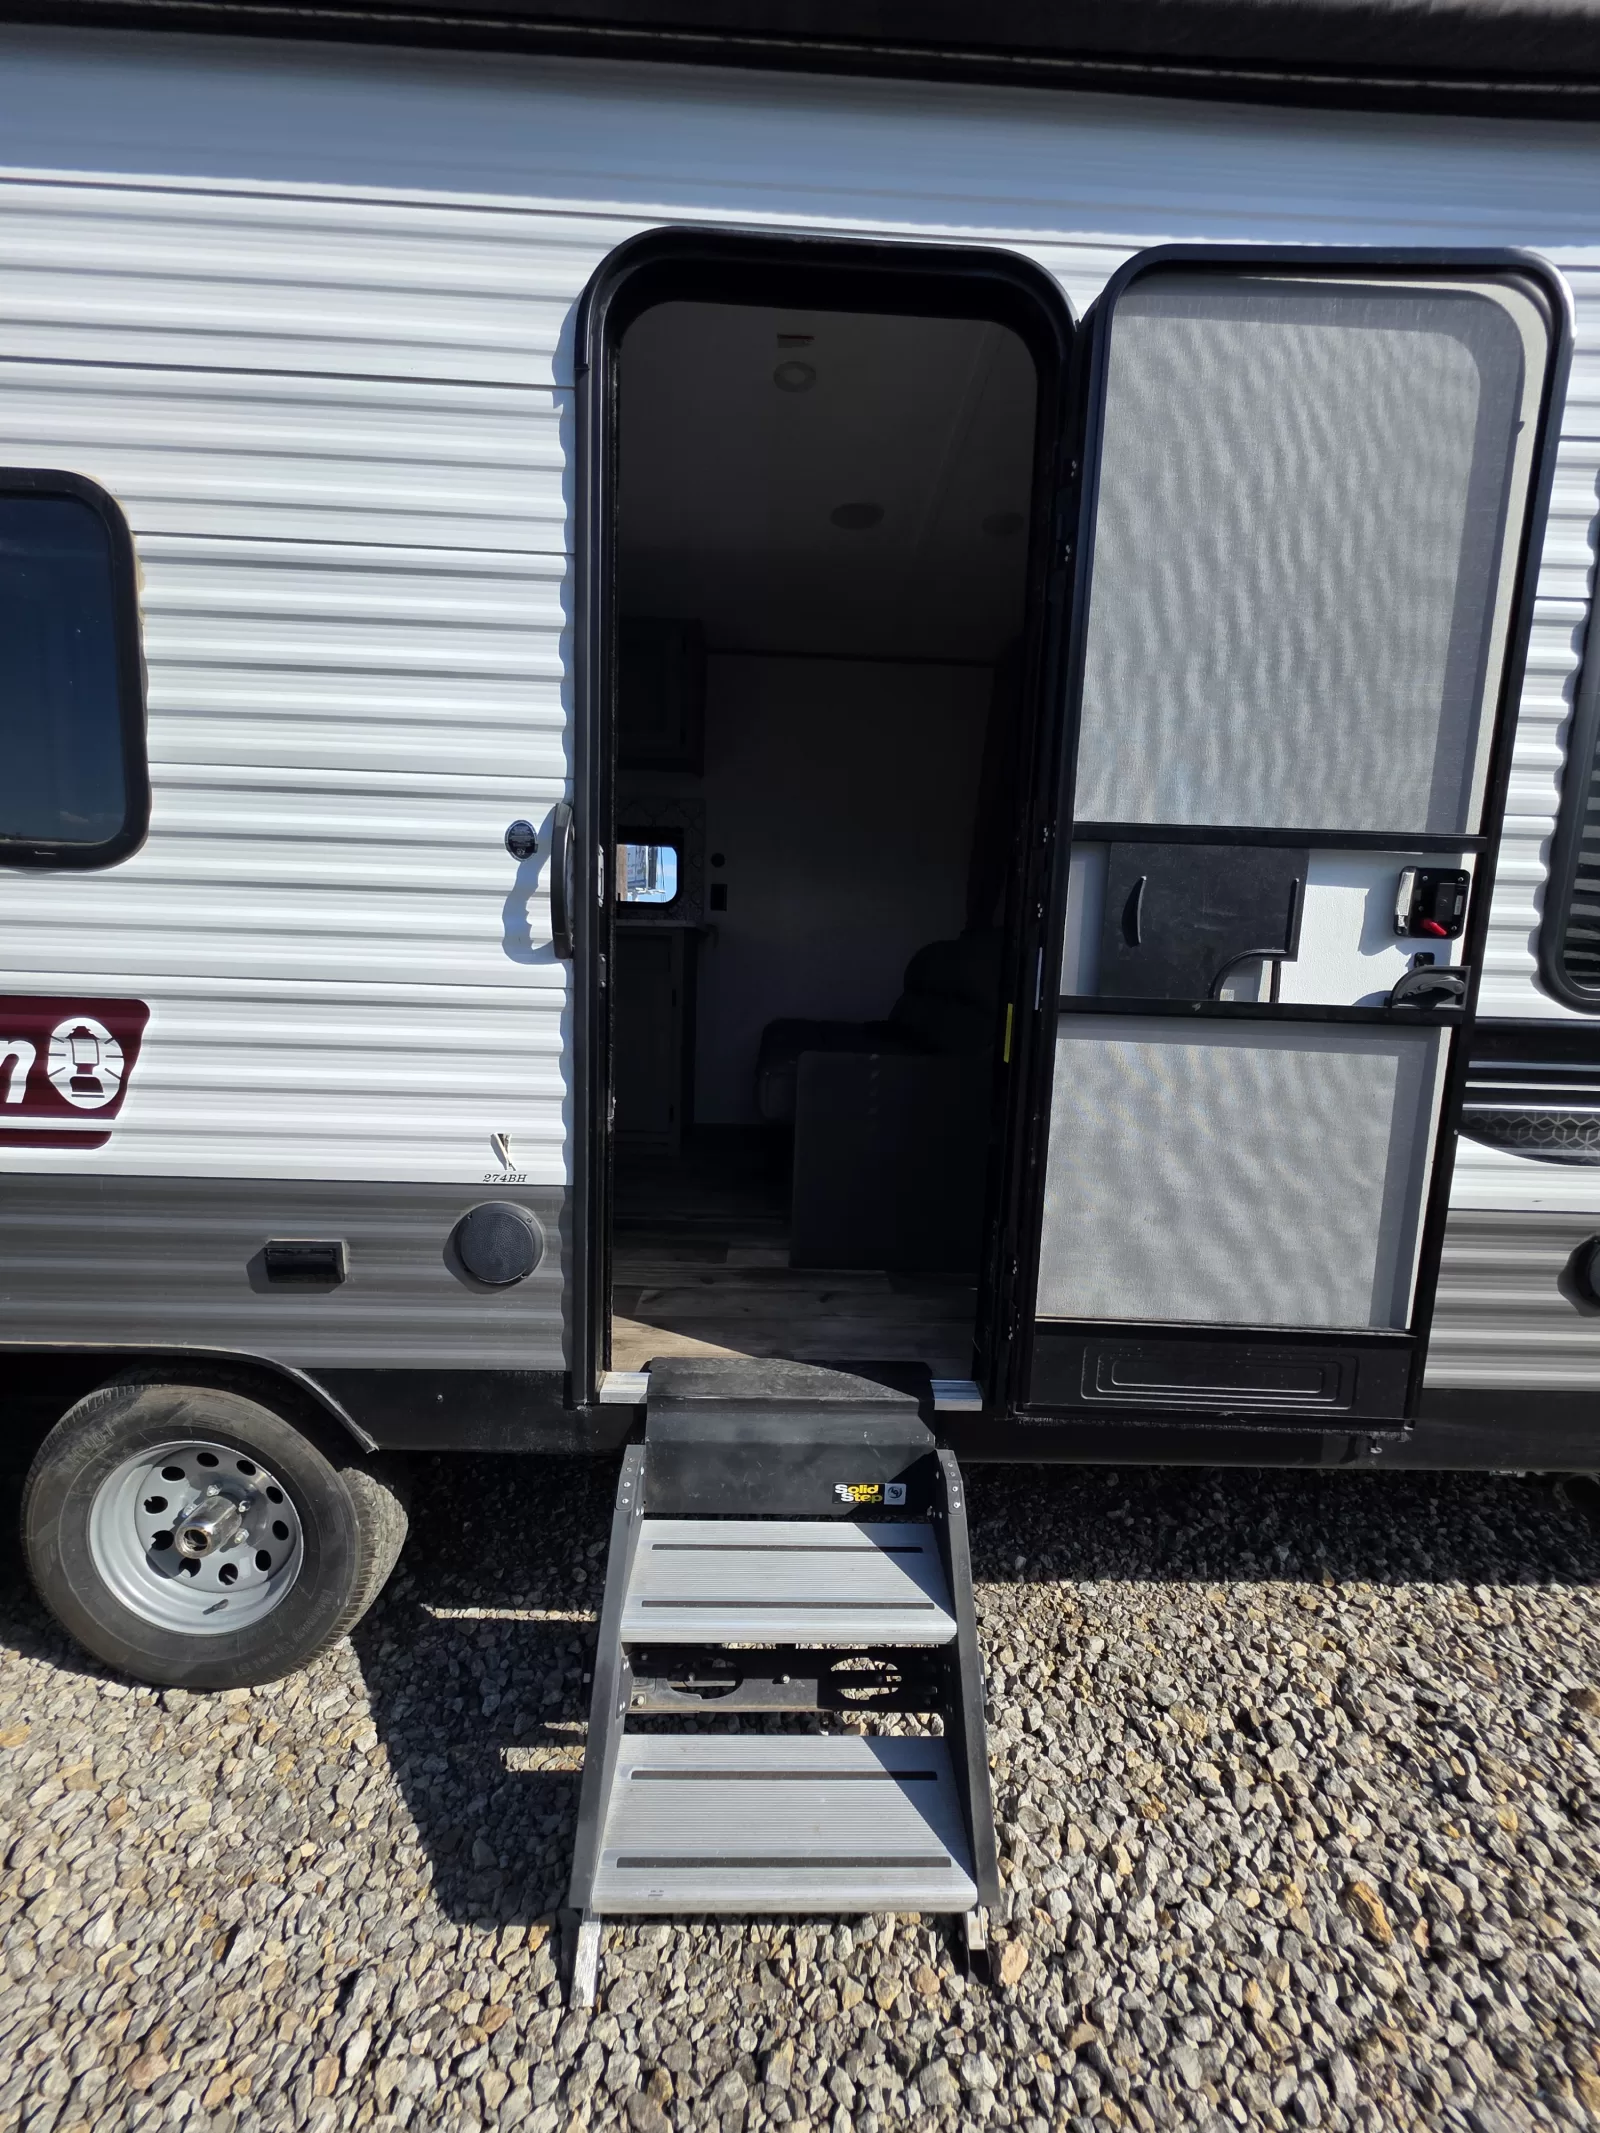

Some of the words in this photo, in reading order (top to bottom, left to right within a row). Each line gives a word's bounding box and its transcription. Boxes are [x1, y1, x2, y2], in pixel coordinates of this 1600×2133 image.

[483, 1174, 527, 1182] 274BH
[835, 1484, 879, 1493] Solid
[841, 1493, 883, 1503] Step
